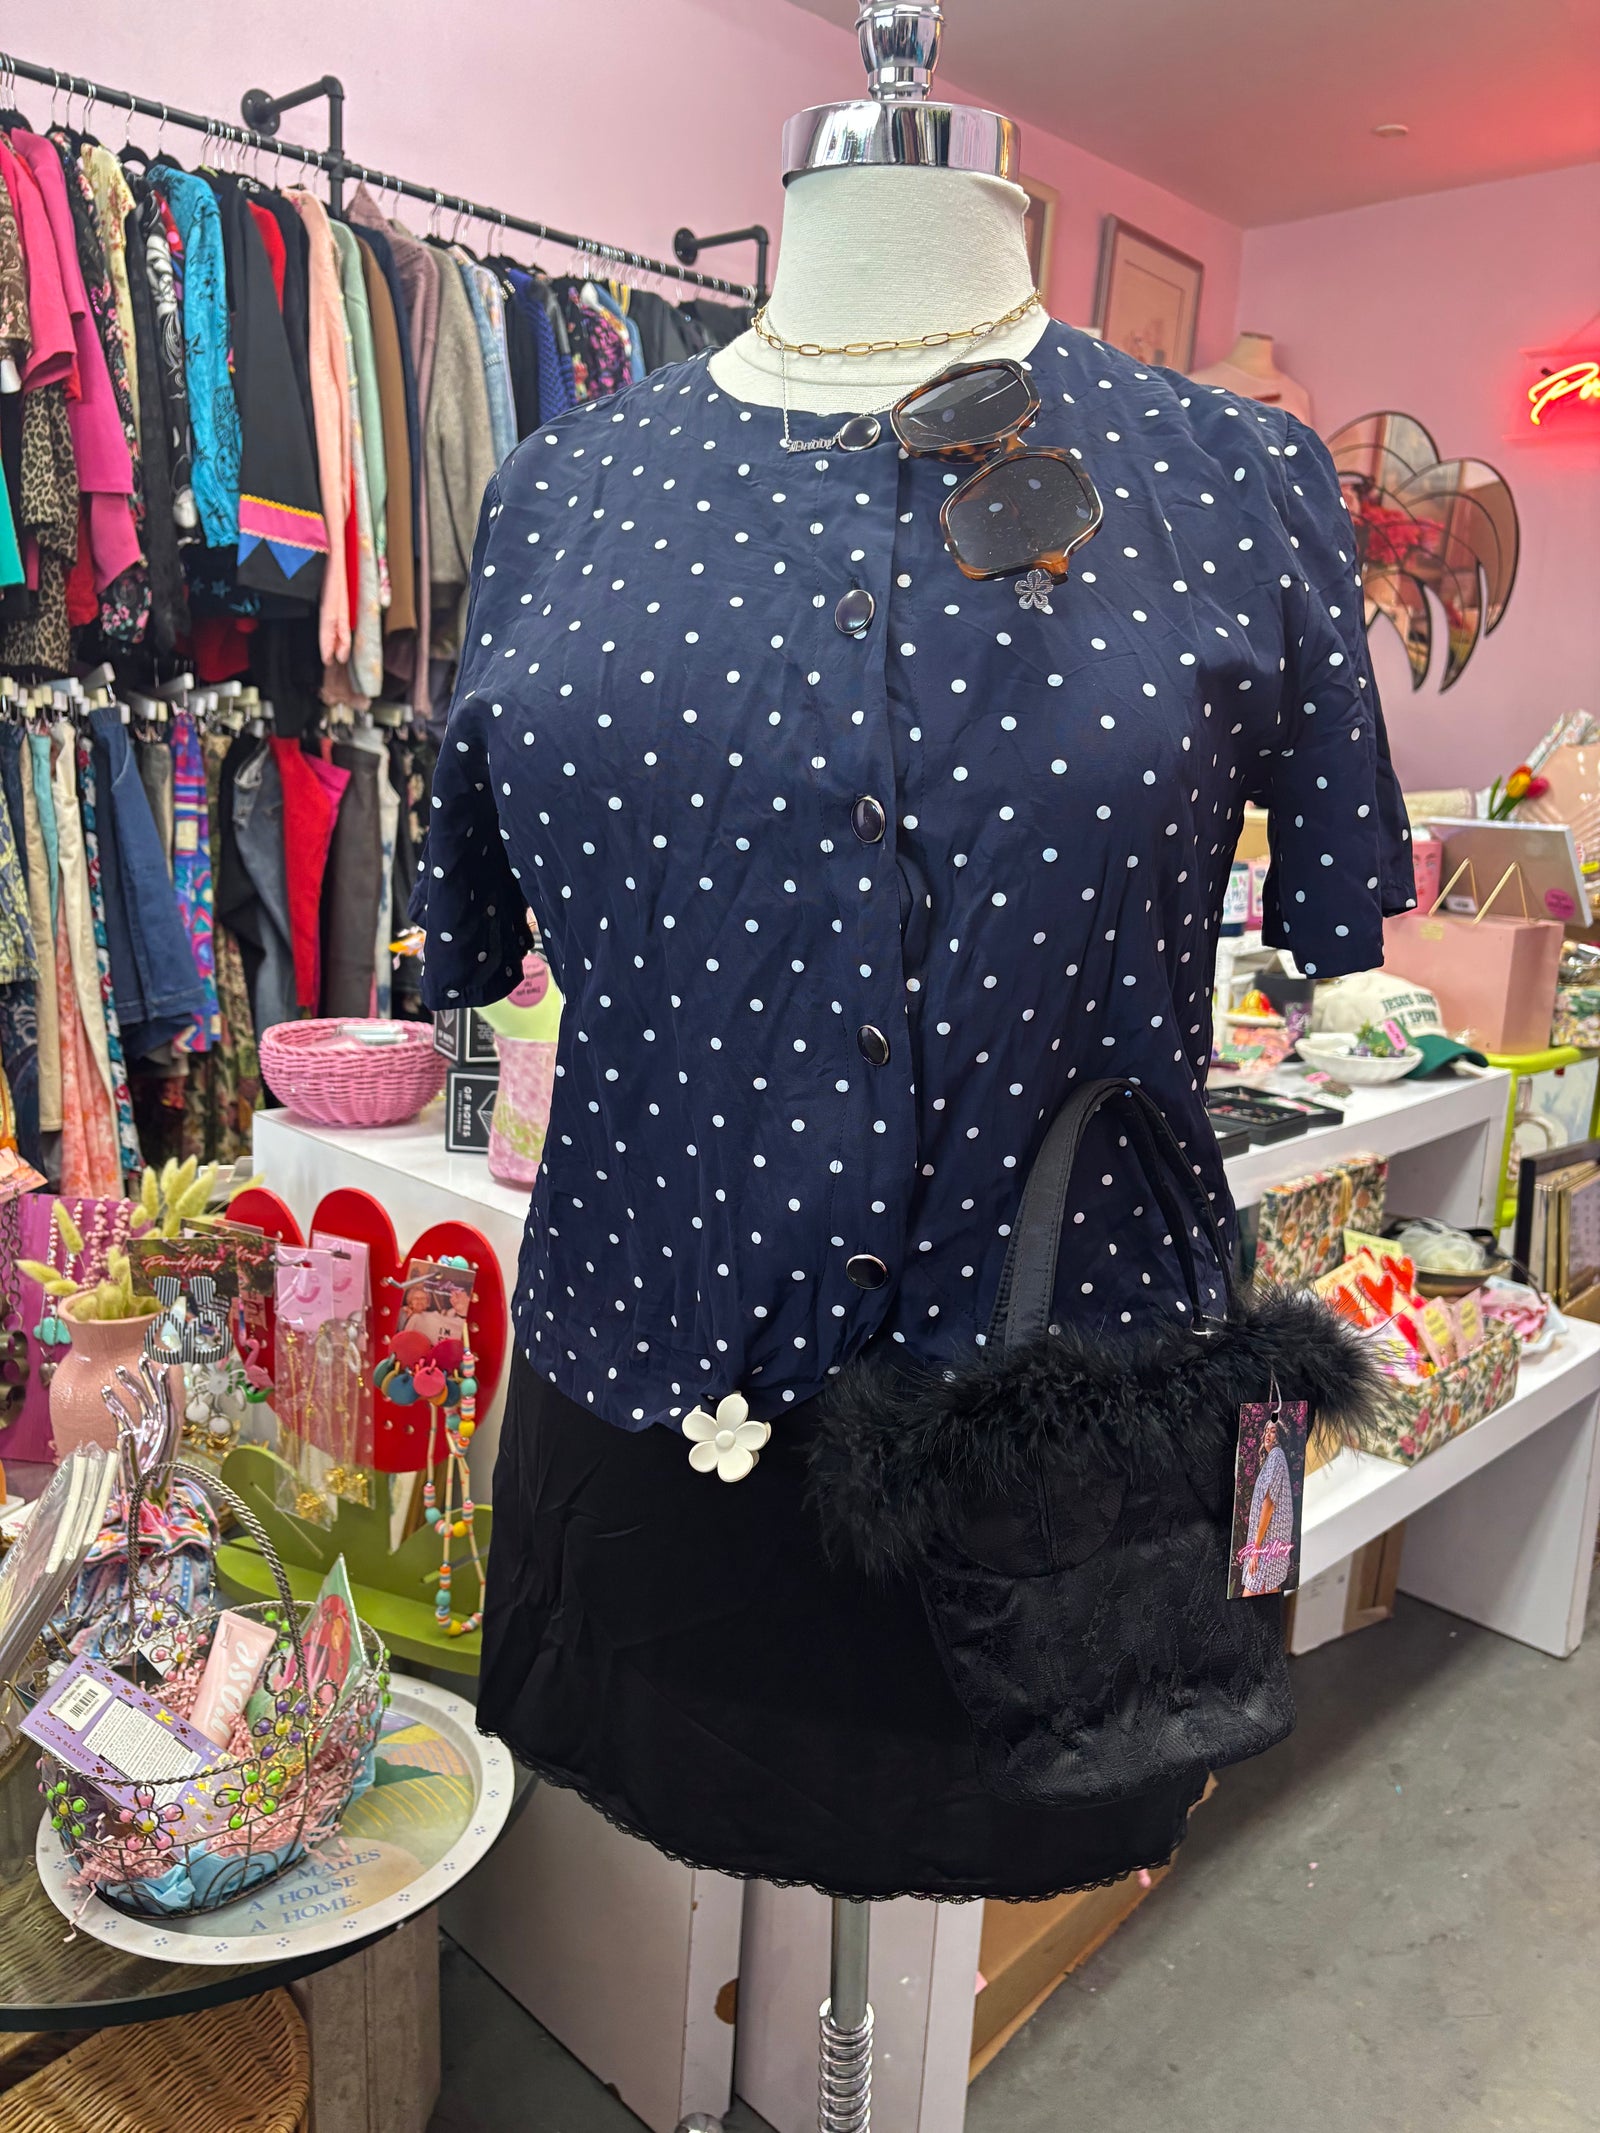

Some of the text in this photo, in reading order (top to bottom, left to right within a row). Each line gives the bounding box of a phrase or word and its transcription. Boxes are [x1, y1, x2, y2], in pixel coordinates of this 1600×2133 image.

[462, 1085, 473, 1138] OF NOTES
[1237, 1539, 1295, 1564] Proud Mary
[211, 1641, 259, 1739] rose
[34, 1720, 55, 1737] DECO
[63, 1740, 91, 1762] BEAUTY
[248, 1874, 359, 1914] A HOUSE
[250, 1894, 362, 1933] A HOME.
